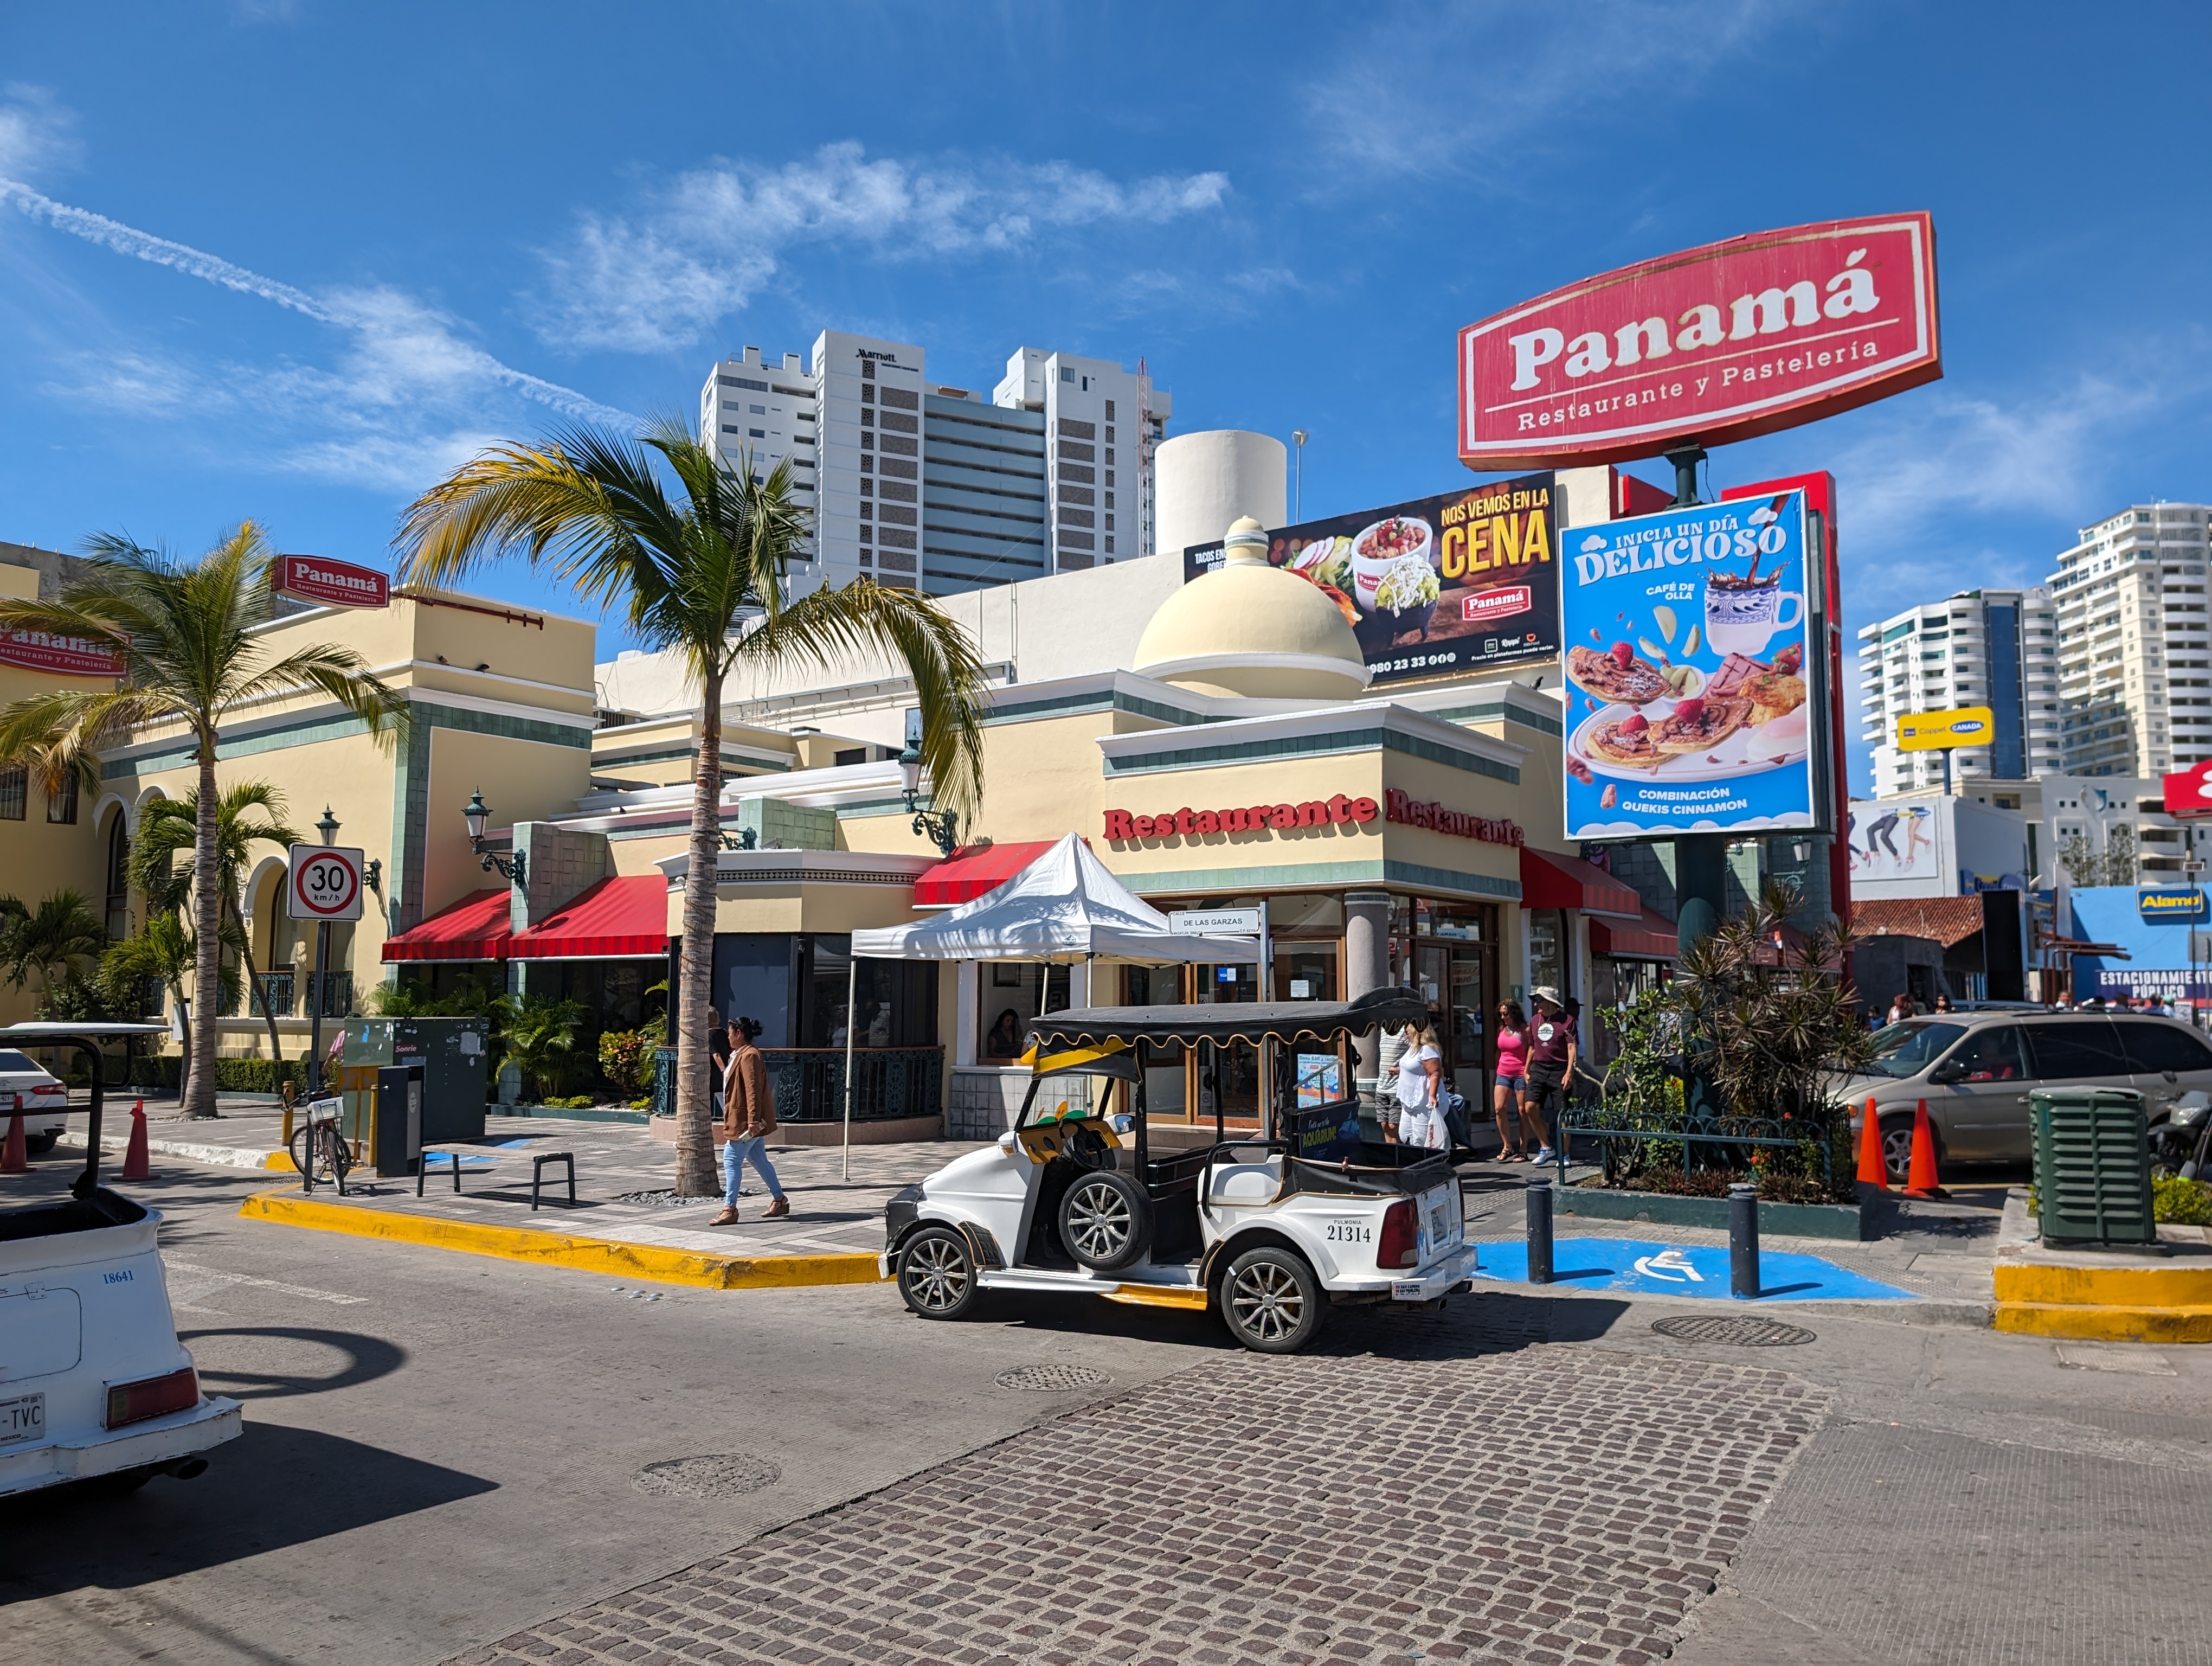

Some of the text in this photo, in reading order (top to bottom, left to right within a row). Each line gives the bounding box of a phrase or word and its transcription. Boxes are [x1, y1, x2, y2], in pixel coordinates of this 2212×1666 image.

[1509, 247, 1880, 391] Panamá
[856, 349, 897, 362] Marriott
[1517, 341, 1879, 431] Restaurante y Pastelería
[1441, 488, 1549, 527] NOS VEMOS EN LA
[1616, 514, 1739, 549] INICIA UN DÍA
[1441, 509, 1551, 579] CENA
[1194, 550, 1215, 565] TACOS
[1574, 525, 1787, 587] DELICIOSO
[294, 562, 378, 592] Panamá
[297, 583, 337, 596] Restaurante
[345, 592, 377, 603] Pastelería
[1646, 581, 1695, 597] CAFÉ DE
[1665, 591, 1693, 600] OLLA
[1469, 589, 1524, 611] Panamá
[0, 647, 53, 661] estaurante
[1471, 653, 1487, 661] Precio
[1494, 650, 1522, 658] plataformas
[1367, 656, 1426, 674] 980 23 33
[1919, 726, 1946, 735] Coppel
[1952, 722, 1982, 731] CANADA
[1638, 787, 1730, 799] COMBINACIÓN
[1622, 799, 1747, 815] QUEKIS CINNAMON
[1103, 793, 1378, 841] Restaurante
[1385, 788, 1525, 847] Restaurante
[311, 865, 345, 892] 30
[314, 894, 340, 902] km/h
[2142, 895, 2200, 908] Alamo
[1302, 1126, 1337, 1148] AQUARIUM!
[1327, 1225, 1371, 1243] 21314
[104, 1270, 134, 1284] 18641
